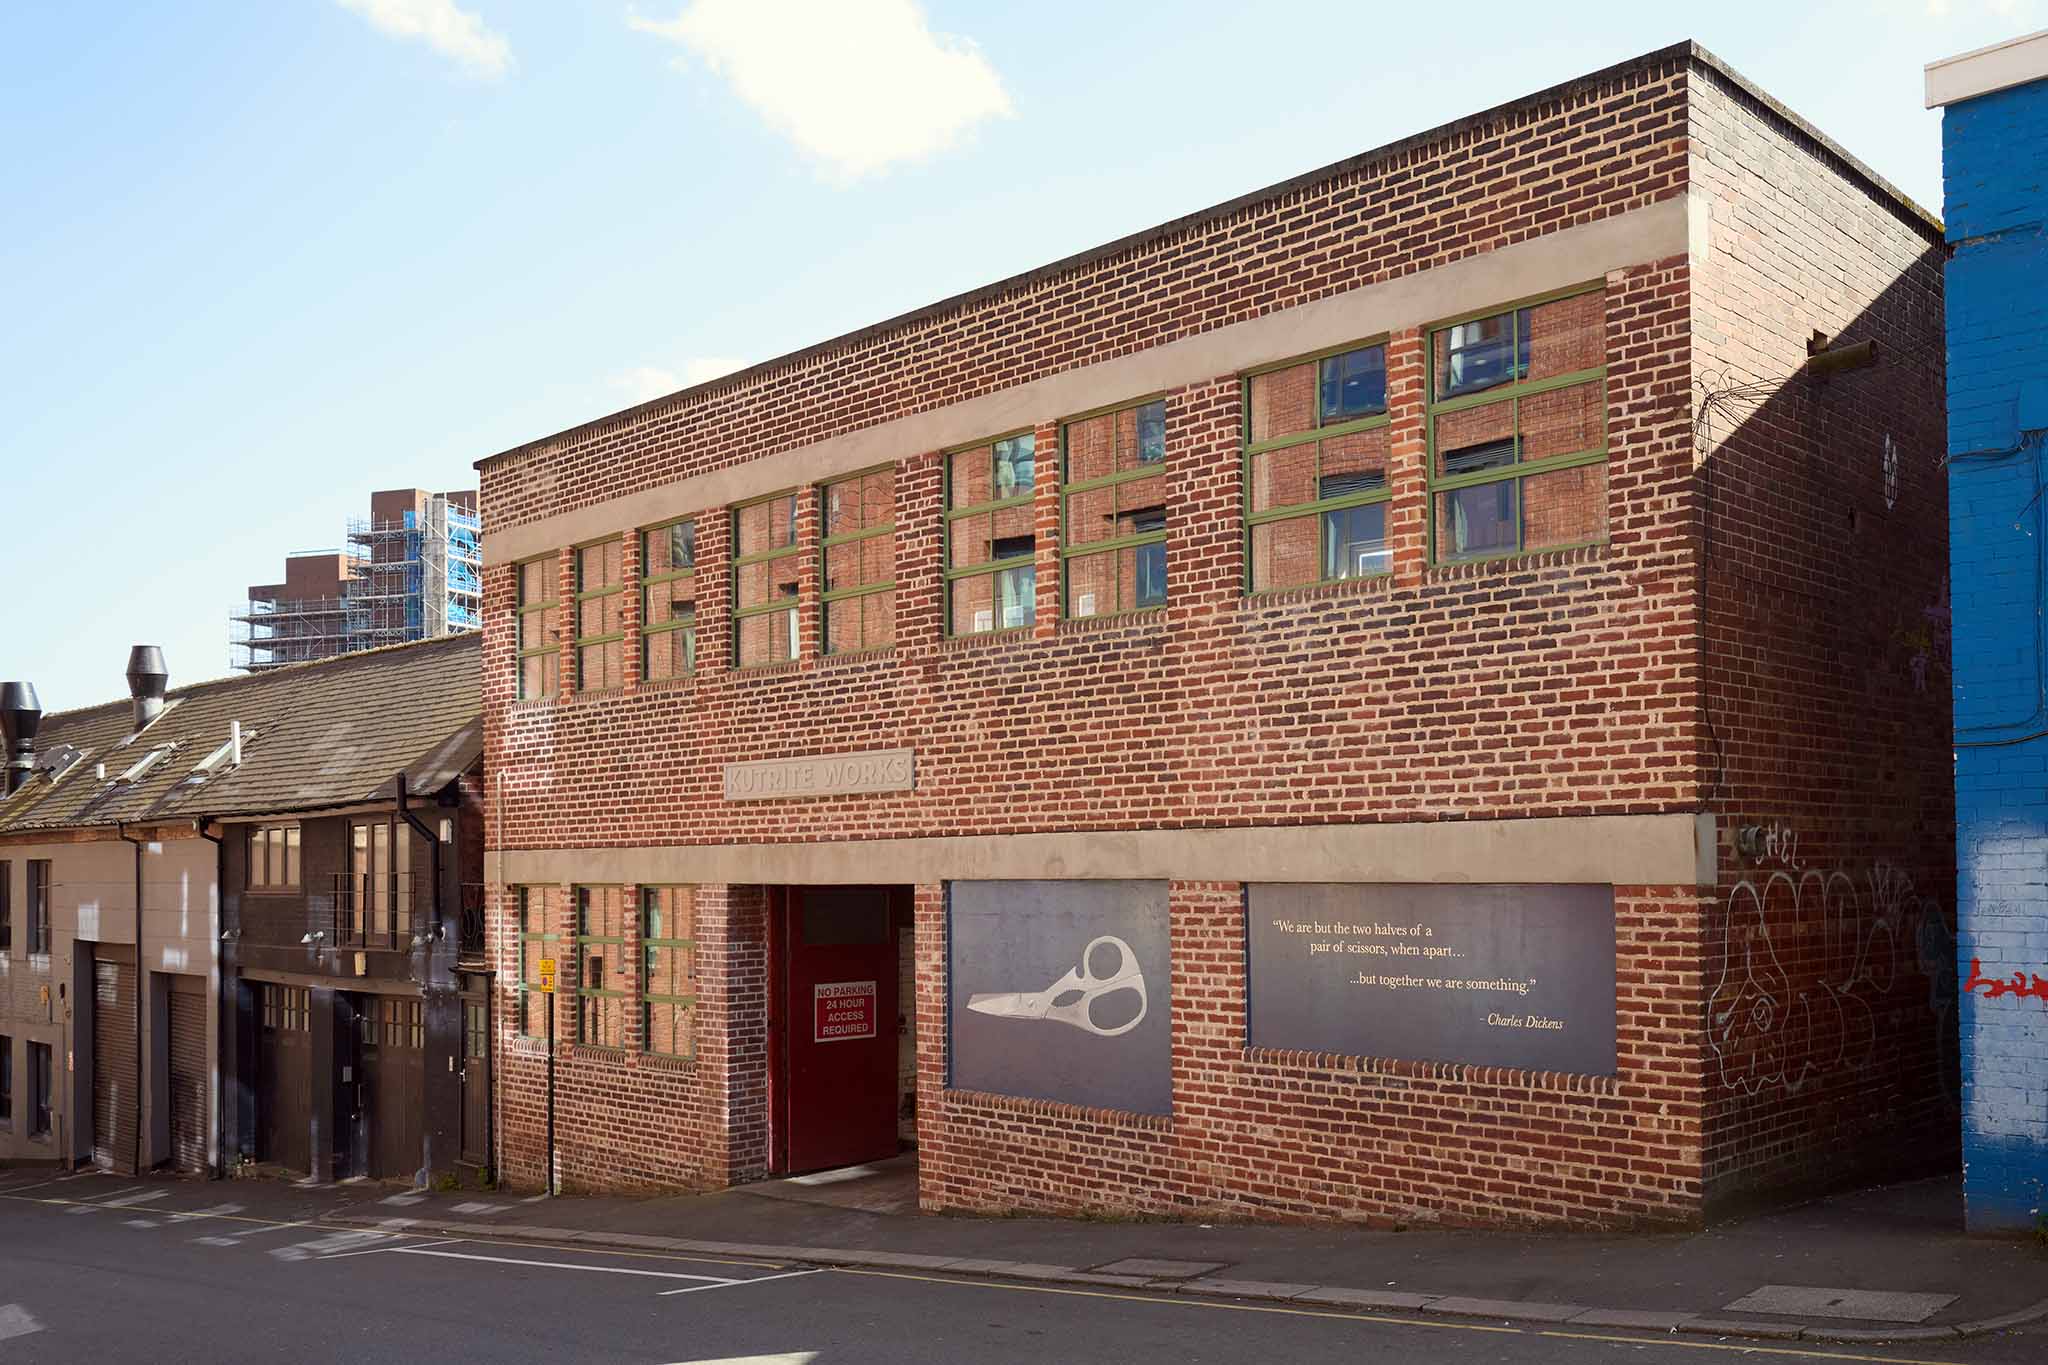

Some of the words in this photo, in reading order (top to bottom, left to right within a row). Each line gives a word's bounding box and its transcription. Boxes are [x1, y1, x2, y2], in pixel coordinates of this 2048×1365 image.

[729, 765, 815, 793] KUTRITE
[825, 758, 908, 788] WORKS
[1296, 923, 1312, 934] are
[1314, 920, 1331, 934] but
[1334, 921, 1351, 934] the
[1352, 924, 1372, 935] two
[1374, 922, 1408, 936] halves
[1410, 923, 1423, 937] of
[1425, 927, 1433, 937] a
[1310, 939, 1330, 956] pair
[1333, 940, 1345, 953] of
[1347, 941, 1388, 957] scissors,
[1390, 942, 1420, 956] when
[1379, 974, 1424, 989] together
[1426, 978, 1442, 988] we
[1444, 978, 1464, 989] are
[817, 988, 831, 997] NO
[833, 984, 873, 996] PARKING
[826, 1000, 837, 1010] 24
[839, 998, 865, 1009] HOUR
[827, 1010, 865, 1022] ACCESS
[1487, 1013, 1522, 1028] Charles
[1525, 1015, 1564, 1031] Dickens
[823, 1023, 869, 1036] REQUIRED
